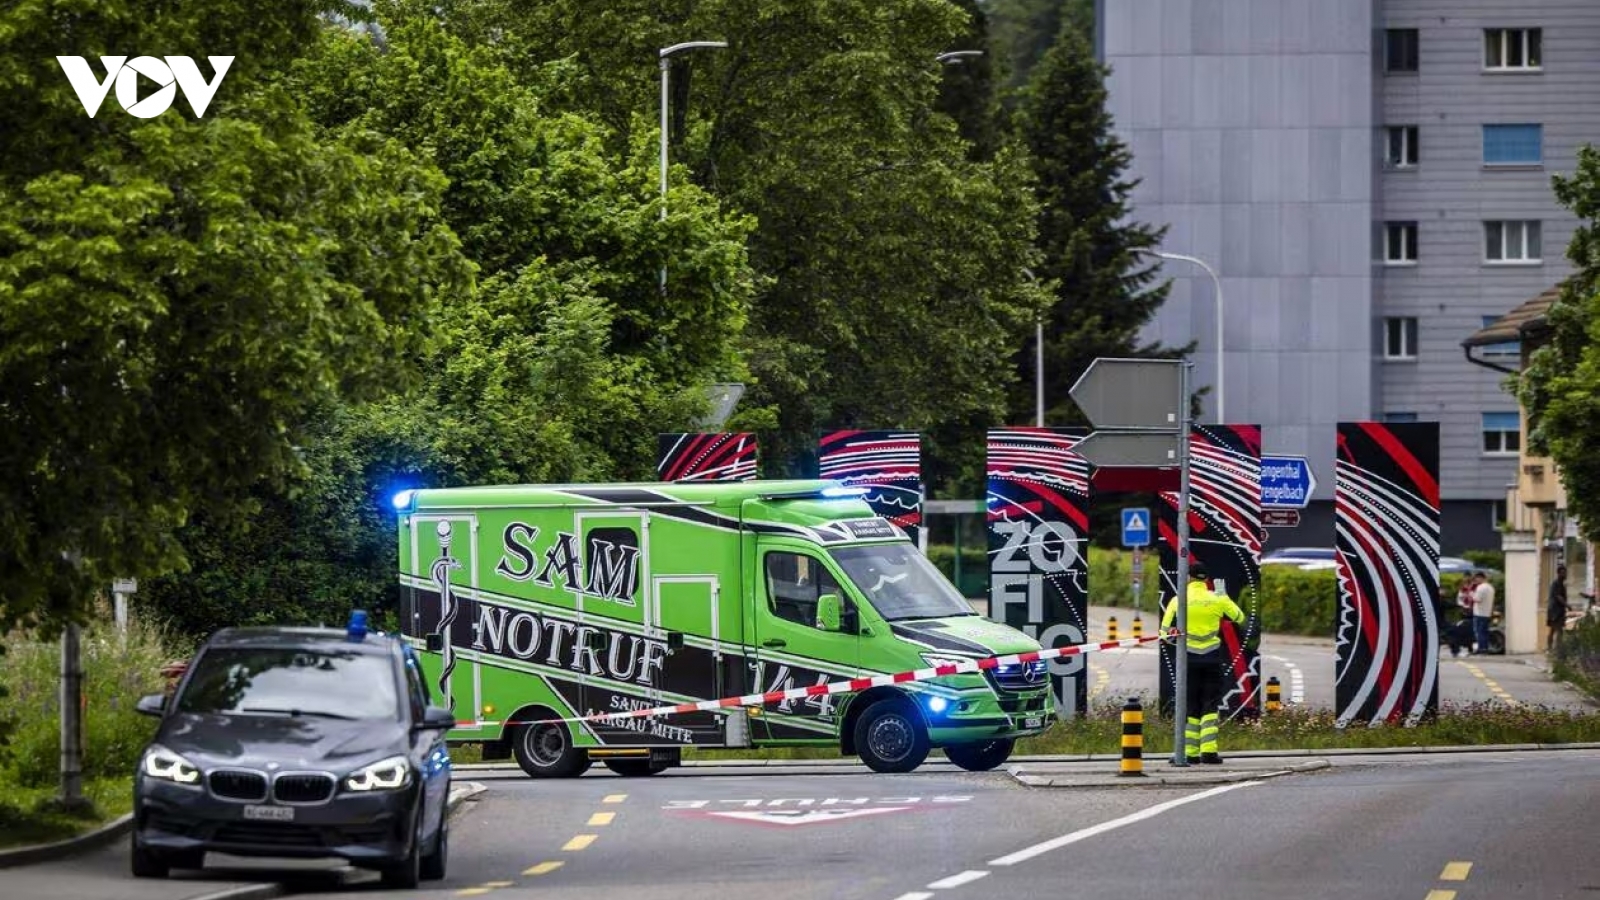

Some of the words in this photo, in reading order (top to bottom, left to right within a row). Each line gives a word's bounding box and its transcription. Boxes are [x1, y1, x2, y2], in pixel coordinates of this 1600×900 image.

[1261, 462, 1300, 481] angenthal
[1261, 483, 1303, 503] rengelbach
[494, 521, 641, 607] SAM
[991, 521, 1079, 572] ZO
[991, 574, 1044, 624] FI
[471, 604, 674, 686] NOTRUF
[1022, 623, 1084, 676] G
[748, 661, 838, 722] 144
[650, 721, 693, 743] MITTE
